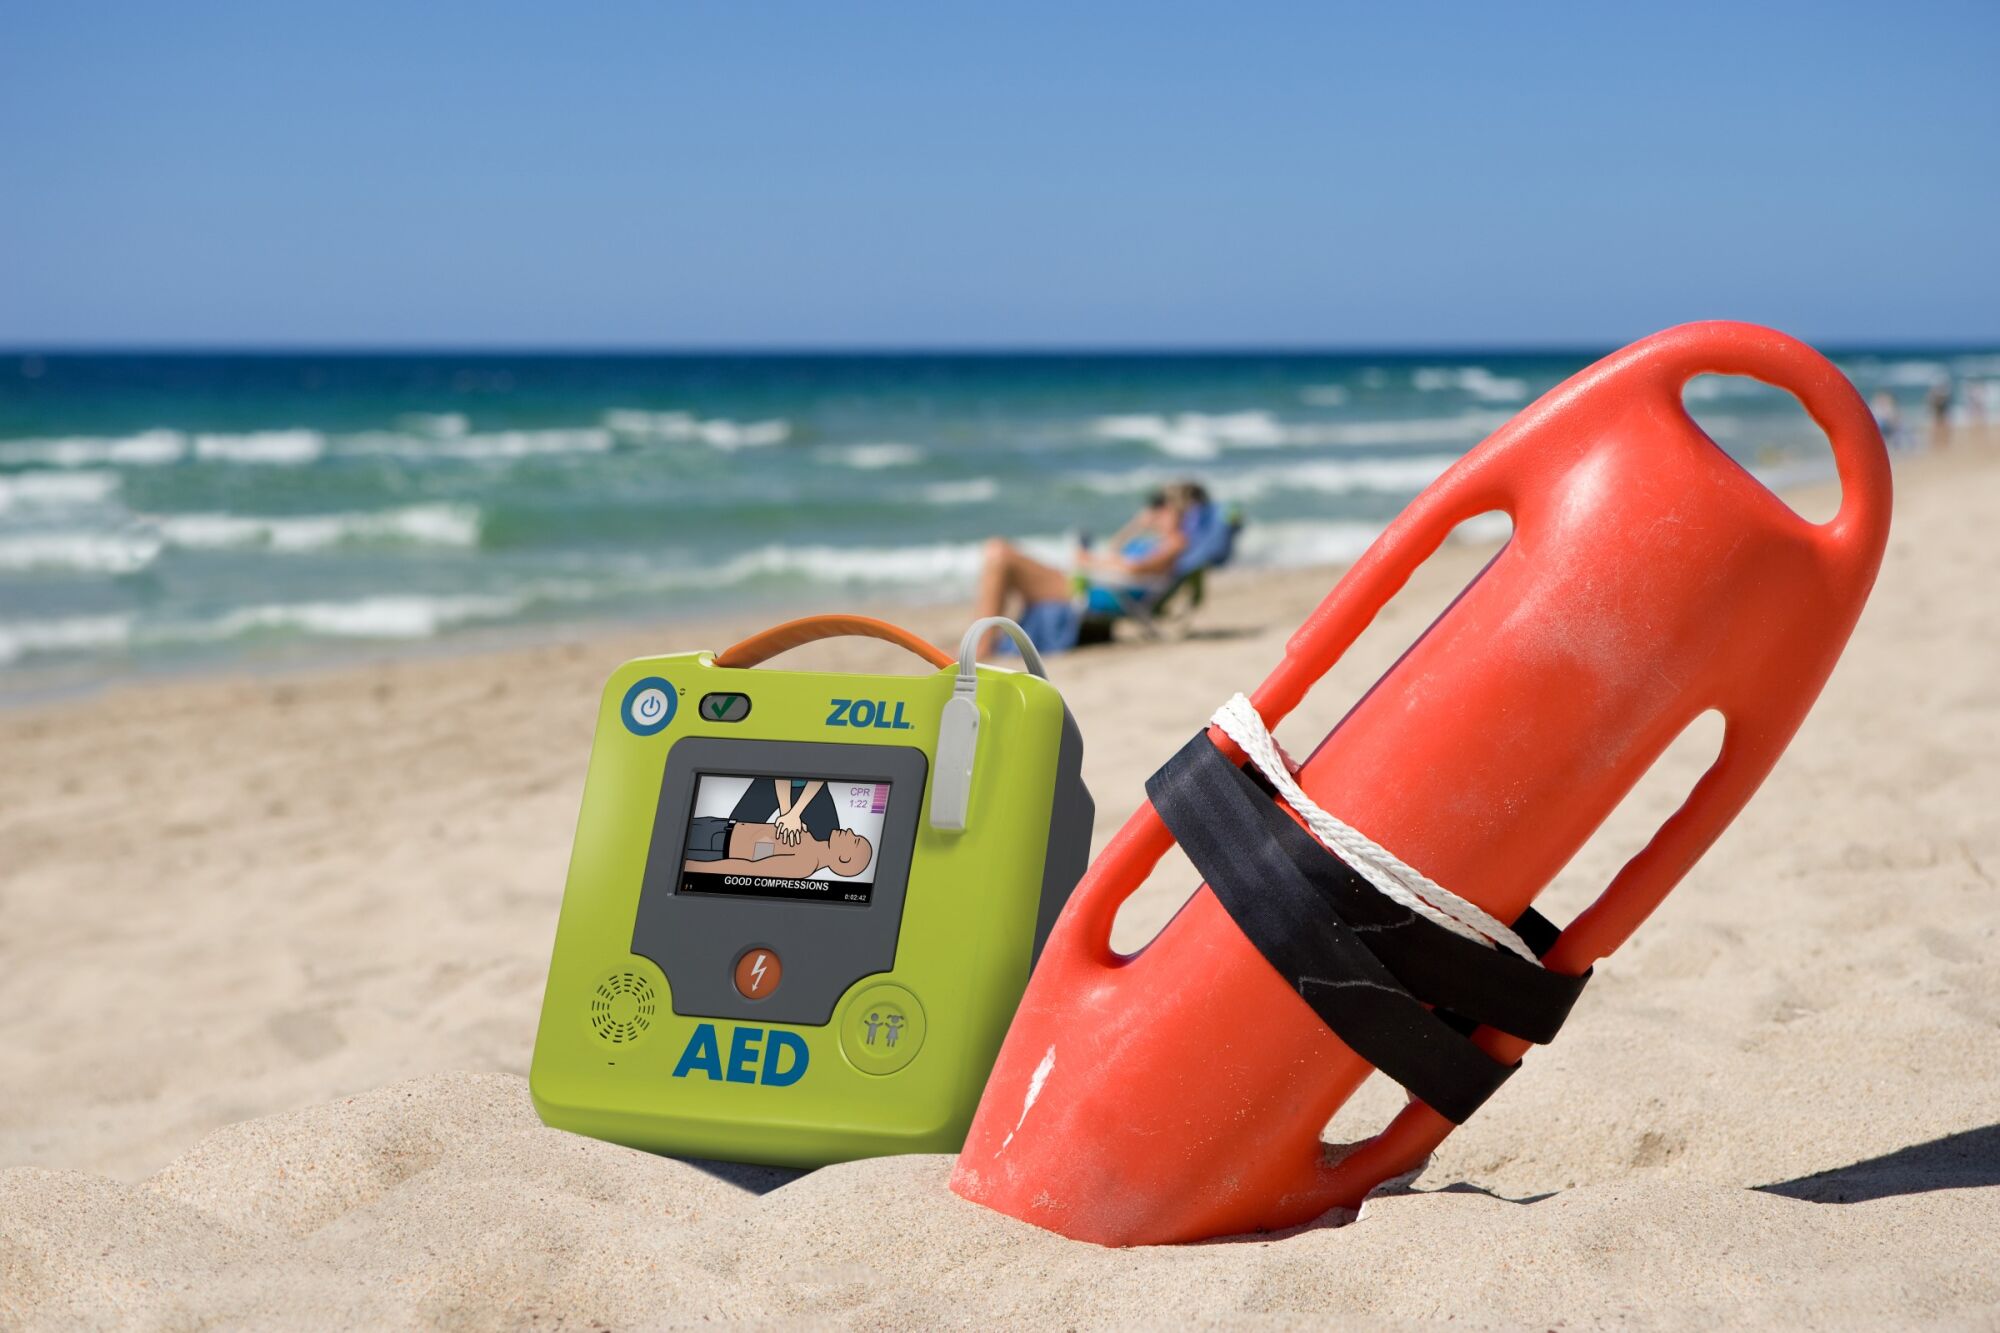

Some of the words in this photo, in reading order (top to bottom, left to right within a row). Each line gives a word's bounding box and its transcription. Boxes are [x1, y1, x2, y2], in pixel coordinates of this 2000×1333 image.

[825, 699, 910, 729] ZOLL
[850, 787, 870, 796] CPR
[850, 799, 868, 808] 1:22
[724, 876, 752, 886] GOOD
[754, 878, 829, 891] COMPRESSIONS
[672, 1023, 809, 1087] AED
